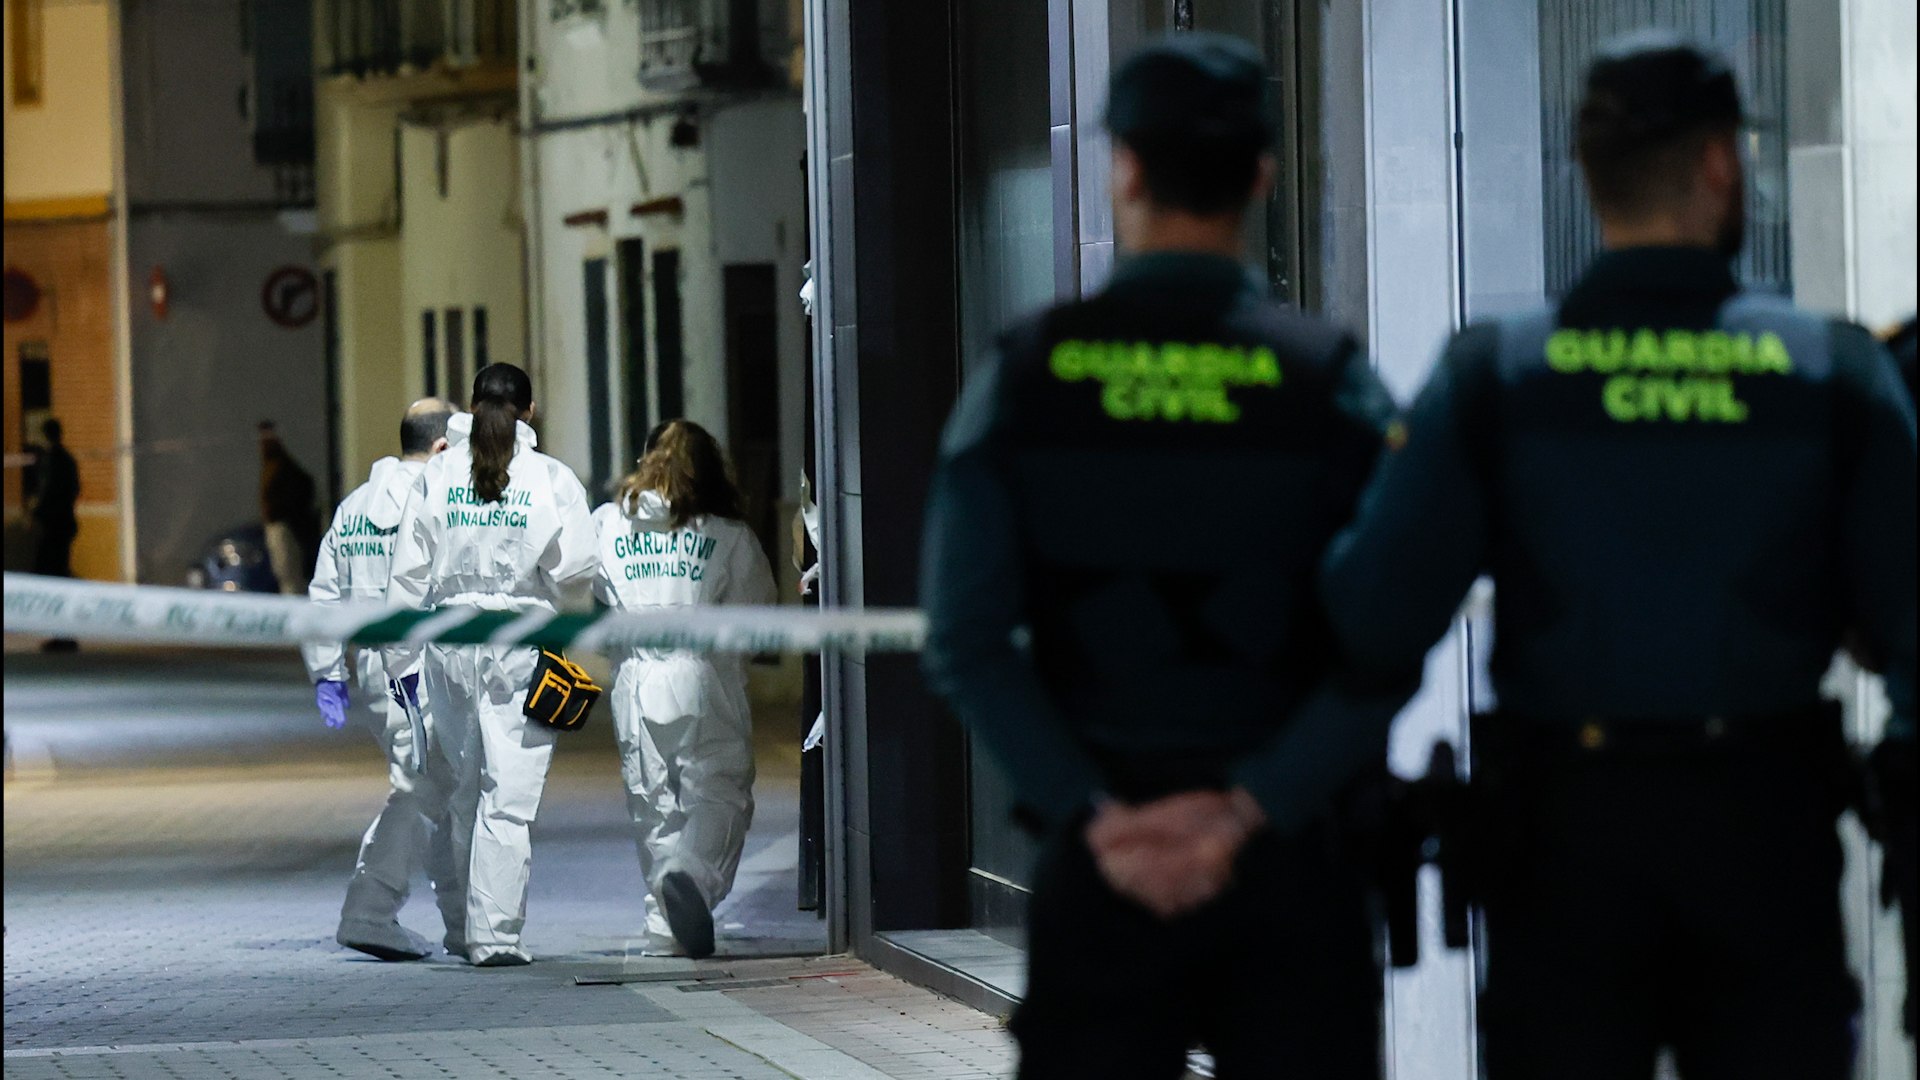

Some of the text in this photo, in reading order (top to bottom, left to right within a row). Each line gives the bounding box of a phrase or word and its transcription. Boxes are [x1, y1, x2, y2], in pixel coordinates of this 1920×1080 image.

[1050, 340, 1282, 387] GUARDIA
[1546, 328, 1792, 375] GUARDIA
[1102, 378, 1240, 422] CIVIL
[1603, 375, 1748, 422] CIVIL
